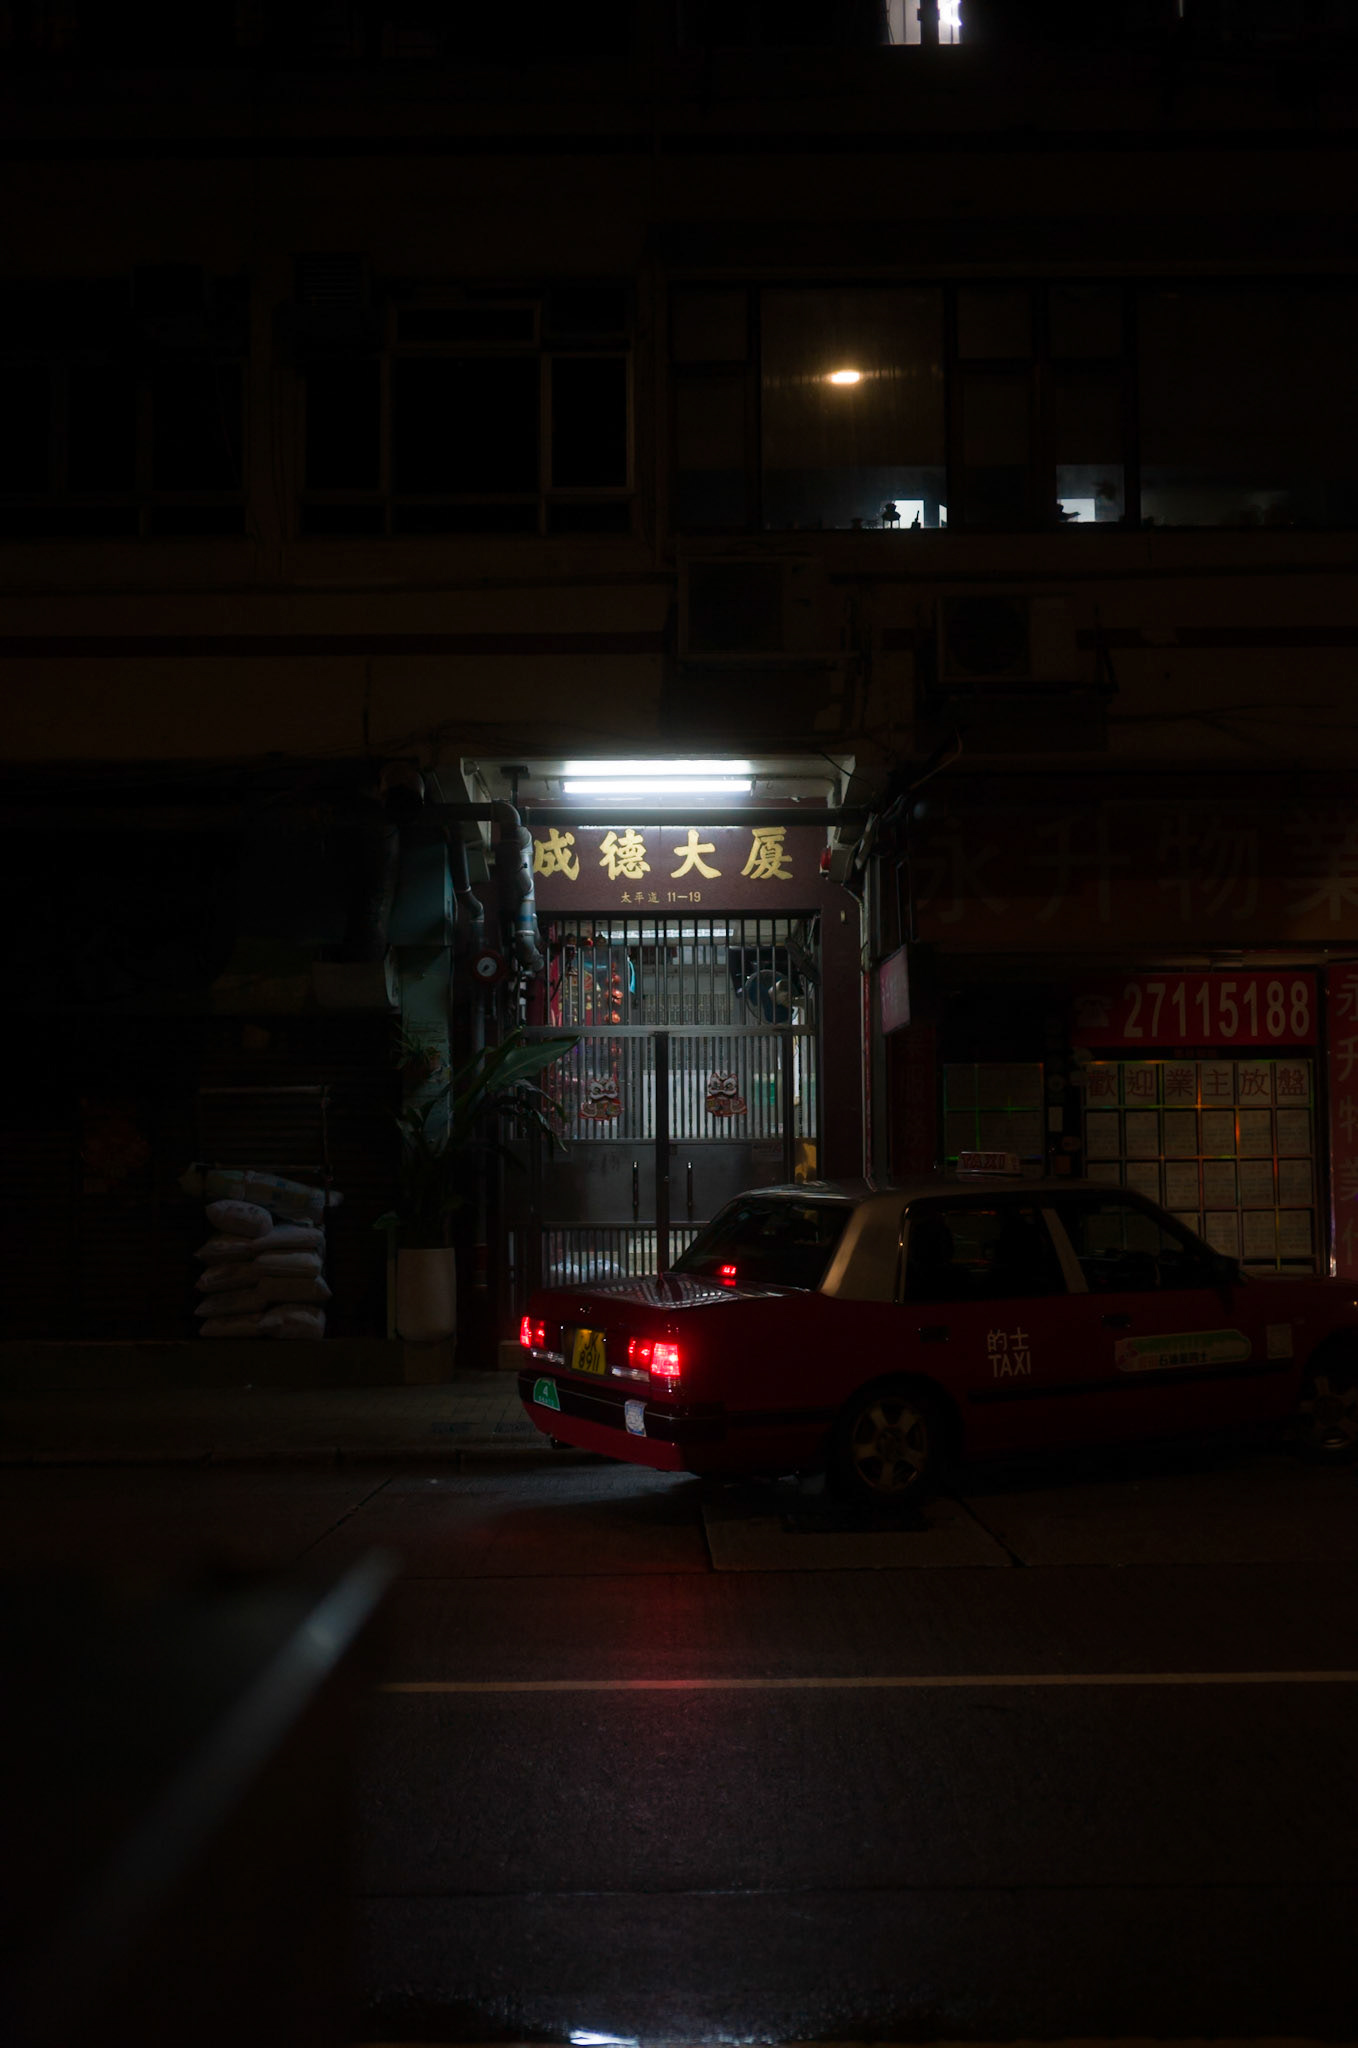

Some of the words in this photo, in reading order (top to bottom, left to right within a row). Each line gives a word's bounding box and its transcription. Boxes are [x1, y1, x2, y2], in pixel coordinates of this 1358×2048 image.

[1122, 980, 1310, 1038] 27115188
[1086, 1067, 1308, 1097] 歡迎業主放盤
[962, 1154, 1006, 1169] TAXI
[987, 1327, 1029, 1352] 的士
[987, 1351, 1031, 1377] TAXI
[543, 1385, 549, 1397] 4
